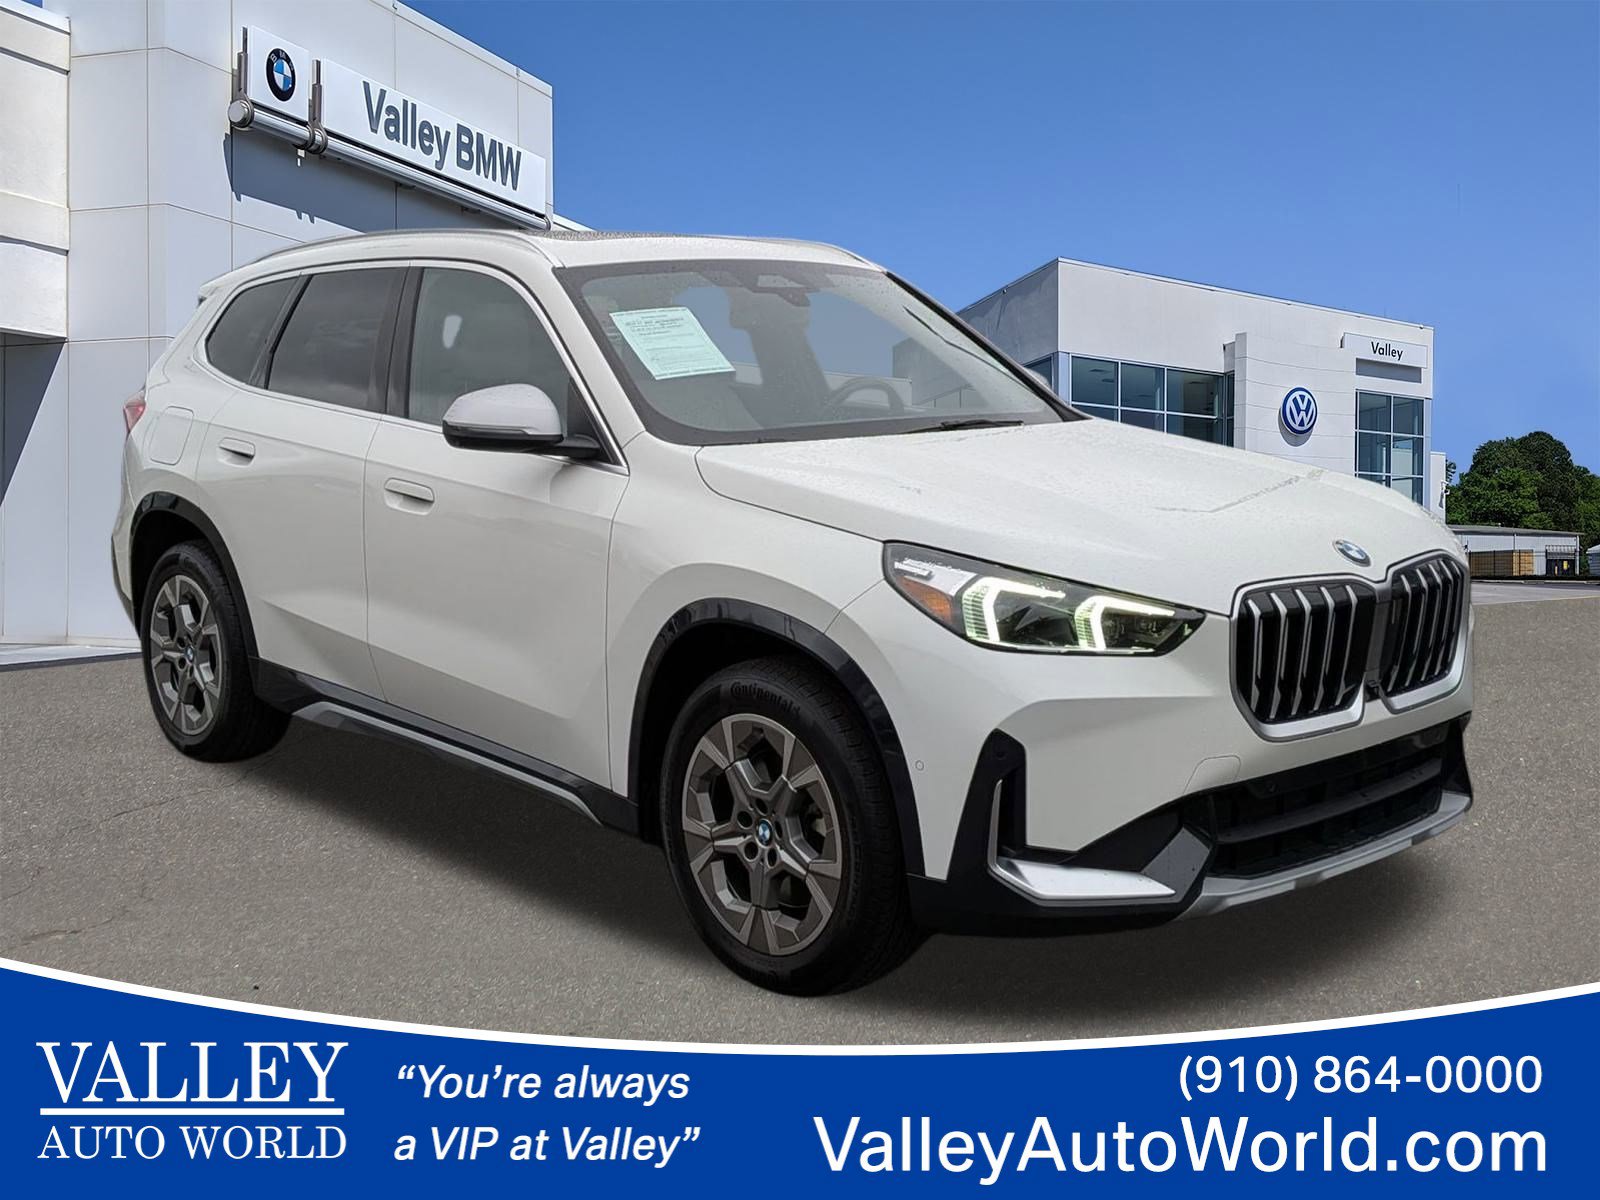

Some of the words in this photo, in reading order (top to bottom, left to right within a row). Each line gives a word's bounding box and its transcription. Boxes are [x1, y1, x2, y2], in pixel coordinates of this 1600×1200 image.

[362, 80, 451, 170] Valley
[455, 122, 522, 192] BMW
[1371, 341, 1403, 361] Valley
